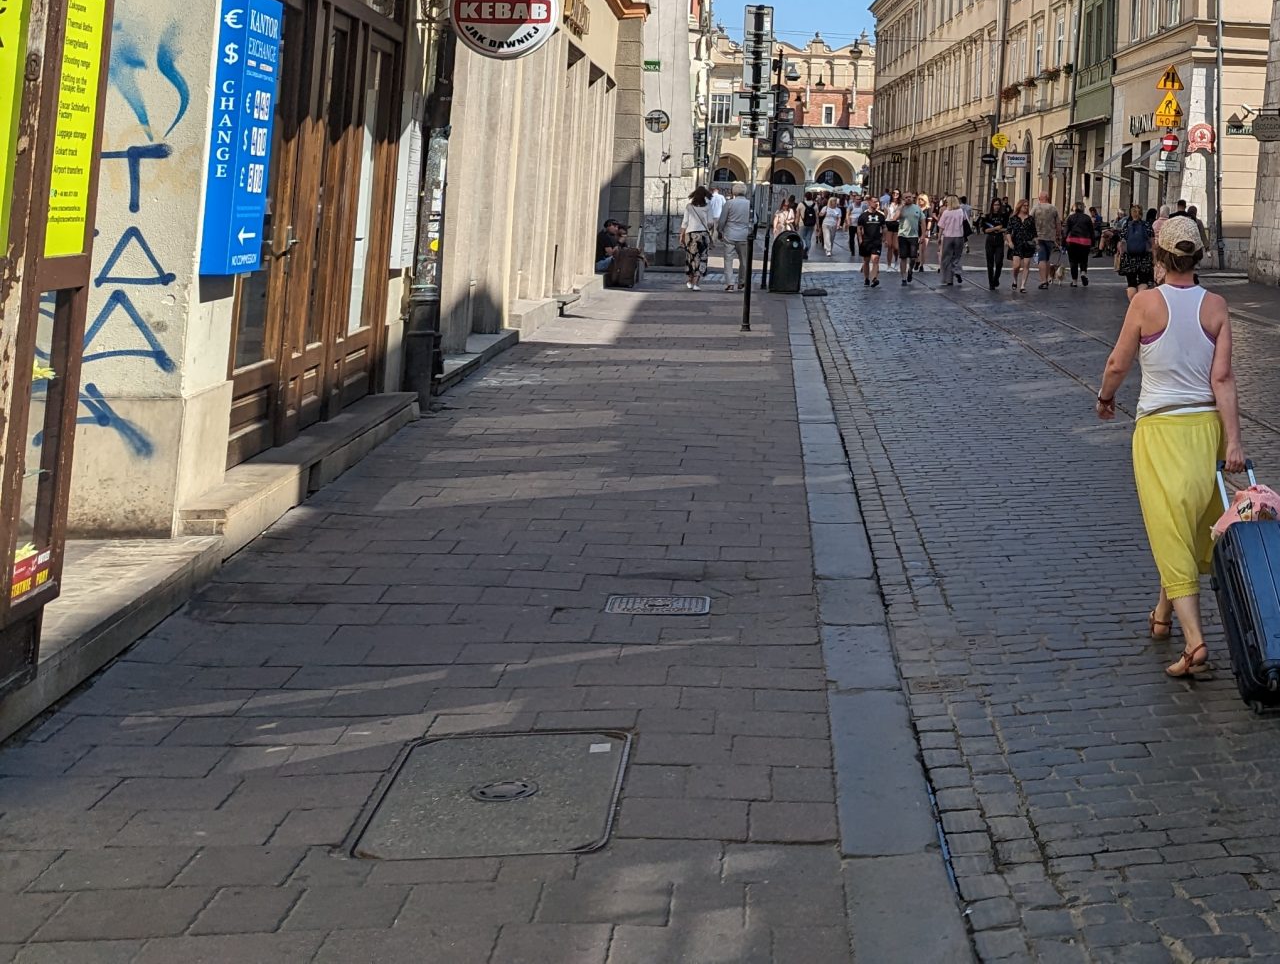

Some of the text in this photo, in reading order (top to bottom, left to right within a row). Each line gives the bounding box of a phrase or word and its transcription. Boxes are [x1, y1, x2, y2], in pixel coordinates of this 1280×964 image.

[459, 2, 548, 20] KEBAB
[250, 9, 279, 39] KANTOR
[465, 25, 540, 49] JAK DAWNIEJ
[248, 37, 277, 63] EXCHANGE
